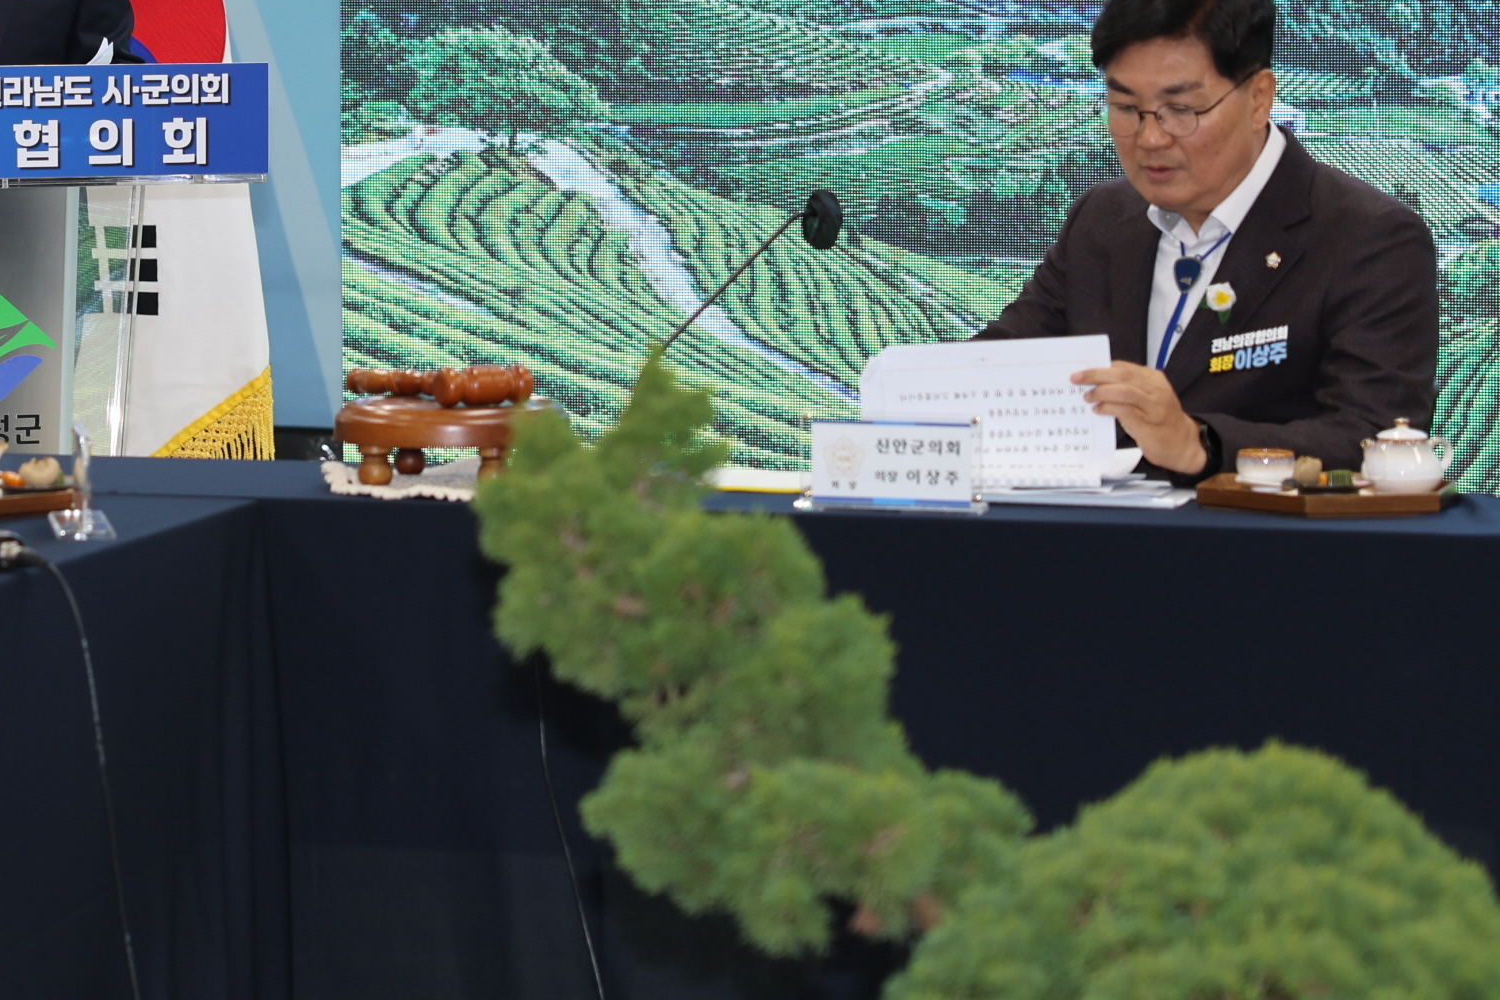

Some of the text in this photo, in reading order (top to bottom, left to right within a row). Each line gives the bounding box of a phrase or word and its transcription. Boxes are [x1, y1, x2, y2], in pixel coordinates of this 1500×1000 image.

[101, 72, 231, 106] 시·군의회
[1211, 324, 1289, 354] 전남의장협의회
[1208, 341, 1288, 373] 회장 이상주
[875, 438, 962, 457] 신안군의회
